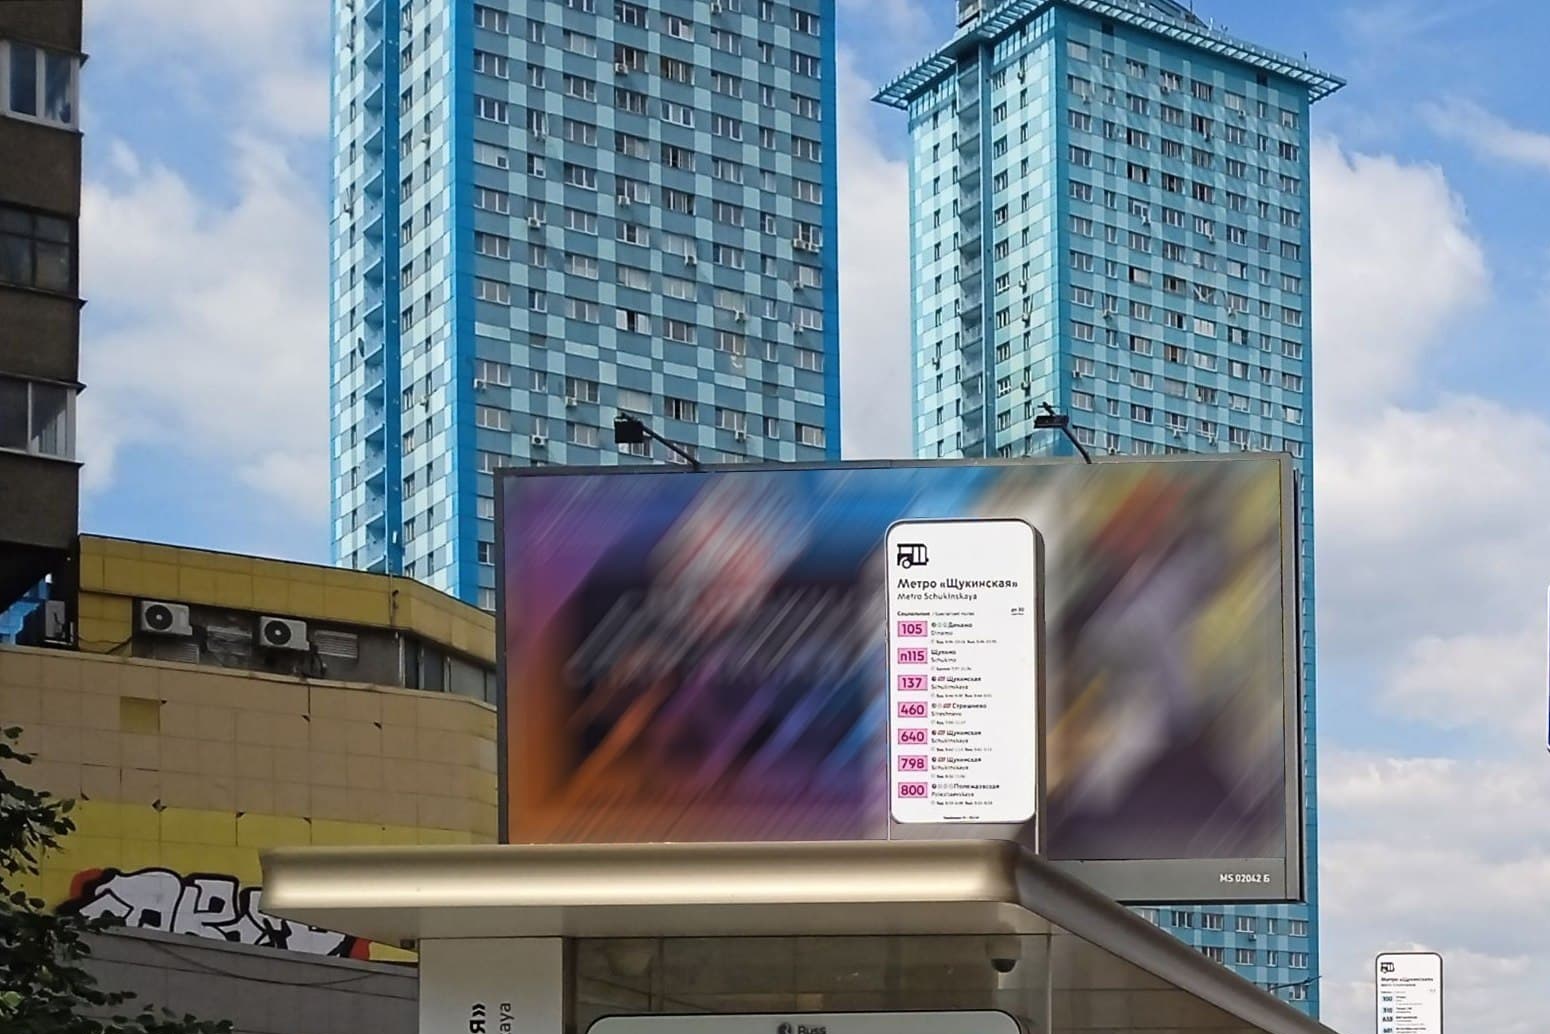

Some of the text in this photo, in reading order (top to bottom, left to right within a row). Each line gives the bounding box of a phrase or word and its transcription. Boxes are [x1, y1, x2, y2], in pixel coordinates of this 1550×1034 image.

[897, 578, 1018, 591] Метро «Щукинская»
[923, 593, 977, 601] Schukinskaya
[902, 623, 923, 635] 105
[902, 677, 922, 688] 137
[901, 704, 925, 715] 460
[901, 731, 925, 742] 640
[901, 758, 925, 769] 798
[901, 785, 925, 796] 800
[1220, 874, 1234, 883] MS
[1235, 874, 1262, 883] 02042
